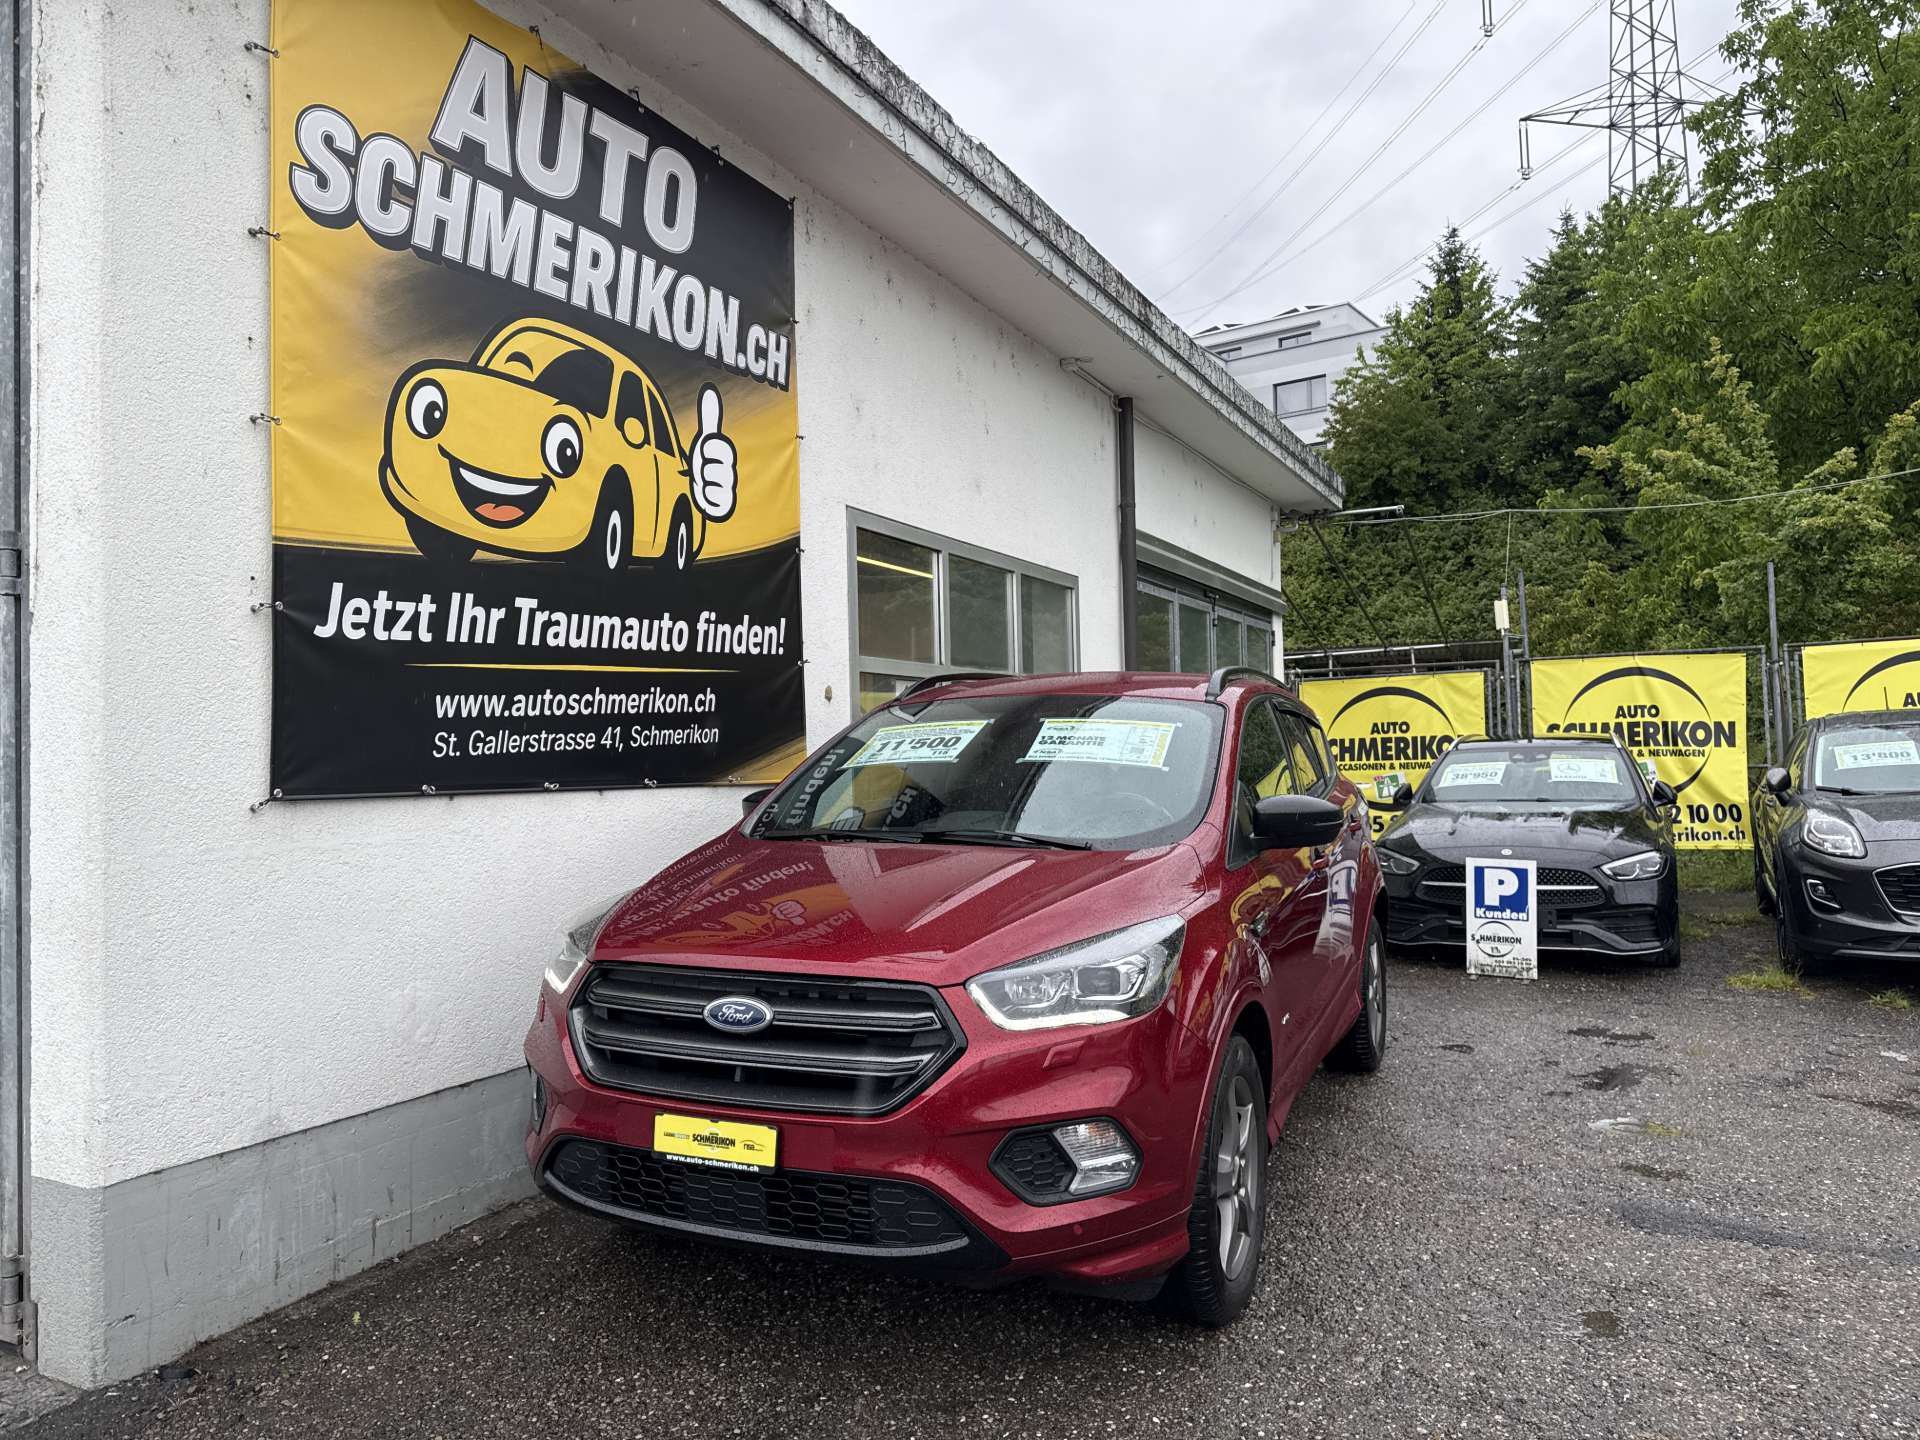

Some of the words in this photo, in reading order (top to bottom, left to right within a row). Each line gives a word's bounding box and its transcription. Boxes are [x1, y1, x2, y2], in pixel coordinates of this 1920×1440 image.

[430, 36, 698, 254] AUTO
[291, 107, 789, 386] SCHMERIKON.CH
[313, 582, 434, 642] Jetzt
[445, 592, 505, 644] Ihr
[514, 597, 689, 653] Traumauto
[696, 614, 786, 655] finden!
[435, 686, 717, 718] www.autoschmerikon.ch
[1903, 692, 1920, 707] A
[1615, 705, 1660, 719] AUTO
[1371, 721, 1411, 735] AUTO
[432, 731, 461, 758] St.
[468, 728, 595, 756] Gallerstrasse
[601, 730, 624, 752] 41,
[629, 724, 720, 748] Schmerikon
[876, 736, 962, 753] 11'500
[1649, 749, 1706, 758] NEUWAGEN
[1337, 763, 1386, 771] CCASIONEN
[1400, 761, 1435, 770] NEUWA
[1687, 804, 1709, 824] 10
[1713, 803, 1743, 823] 00
[1484, 868, 1519, 906] P
[1475, 908, 1527, 921] Kunden
[718, 1004, 753, 1025] Ford
[692, 1133, 736, 1148] SCHMERIKON
[666, 1153, 760, 1173] www.auto-schmerikon.ch
